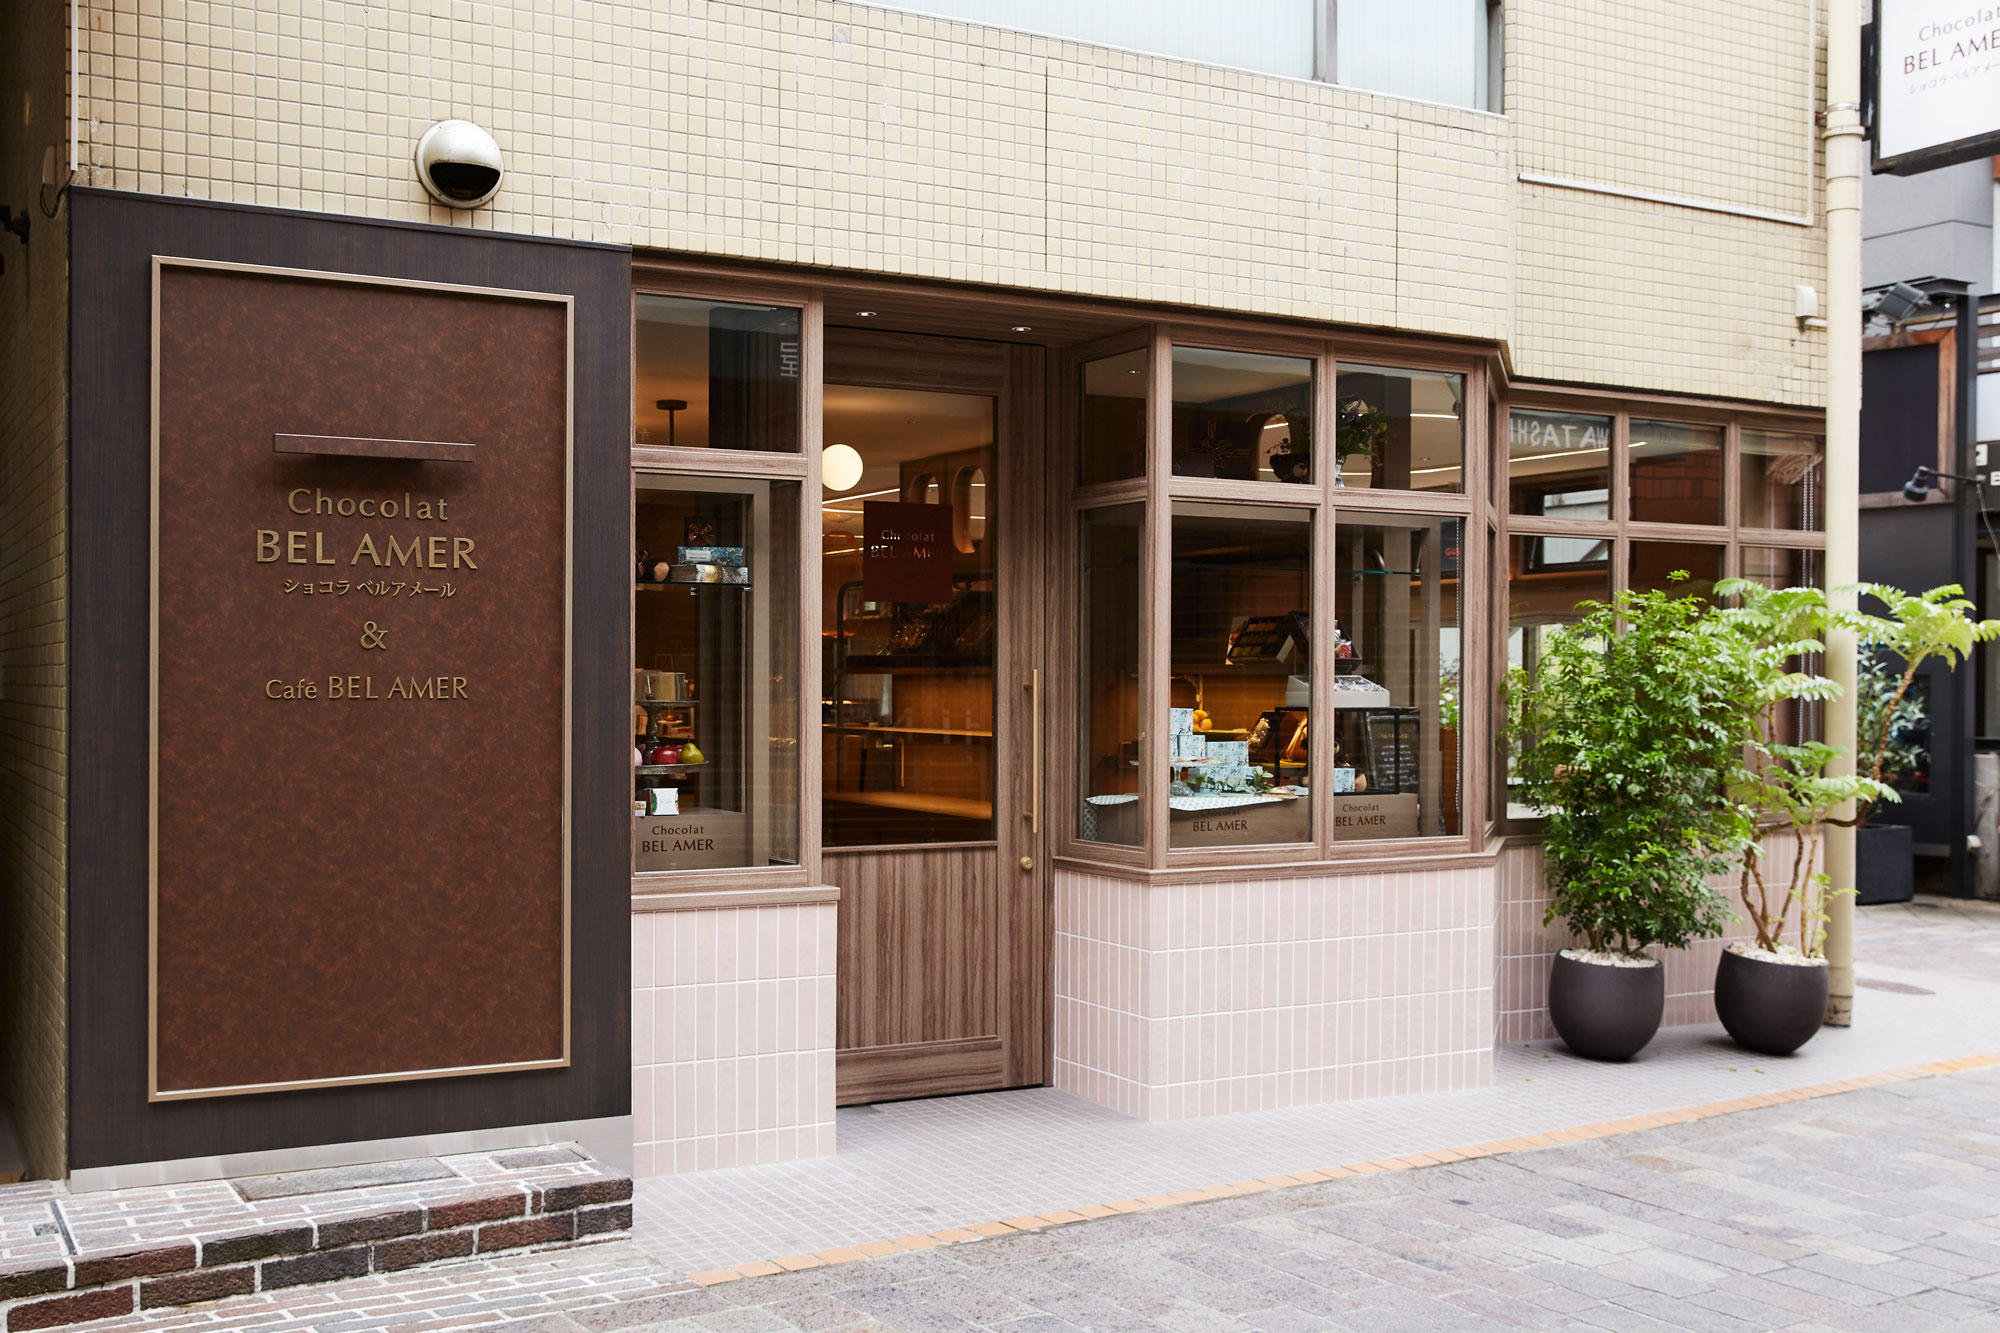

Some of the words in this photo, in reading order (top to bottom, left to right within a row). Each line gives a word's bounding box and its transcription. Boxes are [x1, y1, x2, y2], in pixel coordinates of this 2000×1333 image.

[1904, 48, 1941, 75] BEL
[288, 488, 448, 520] Chocolat
[257, 529, 336, 564] BEL
[350, 533, 478, 569] AMER
[360, 620, 388, 650] &
[265, 678, 317, 699] Café
[328, 676, 378, 699] BEL
[388, 676, 469, 699] AMER
[1342, 803, 1379, 812] Chocolat
[1193, 820, 1212, 832] BEL
[1216, 819, 1248, 831] AMER
[1336, 816, 1353, 827] BEL
[1356, 814, 1386, 826] AMER
[652, 825, 704, 835] Chocolat
[642, 840, 667, 852] BEL
[672, 838, 714, 852] AMER
